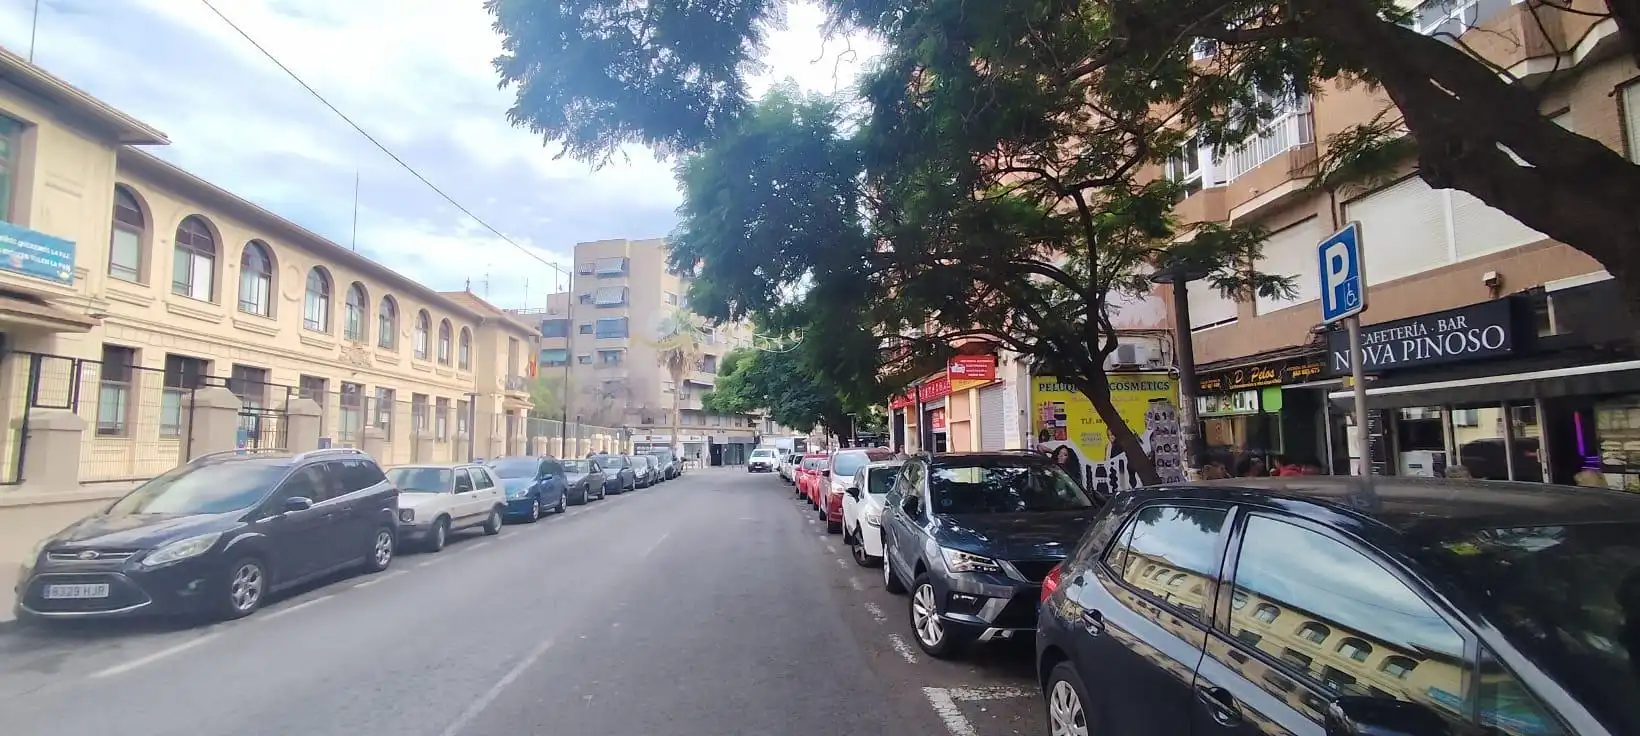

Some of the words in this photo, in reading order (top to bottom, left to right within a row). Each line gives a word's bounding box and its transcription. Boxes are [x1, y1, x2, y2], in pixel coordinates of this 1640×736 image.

[1325, 242, 1350, 311] P
[1438, 315, 1468, 333] BAR
[1402, 325, 1505, 362] PINOSO
[1251, 366, 1275, 383] Pelos
[1109, 381, 1170, 391] COSMETICS
